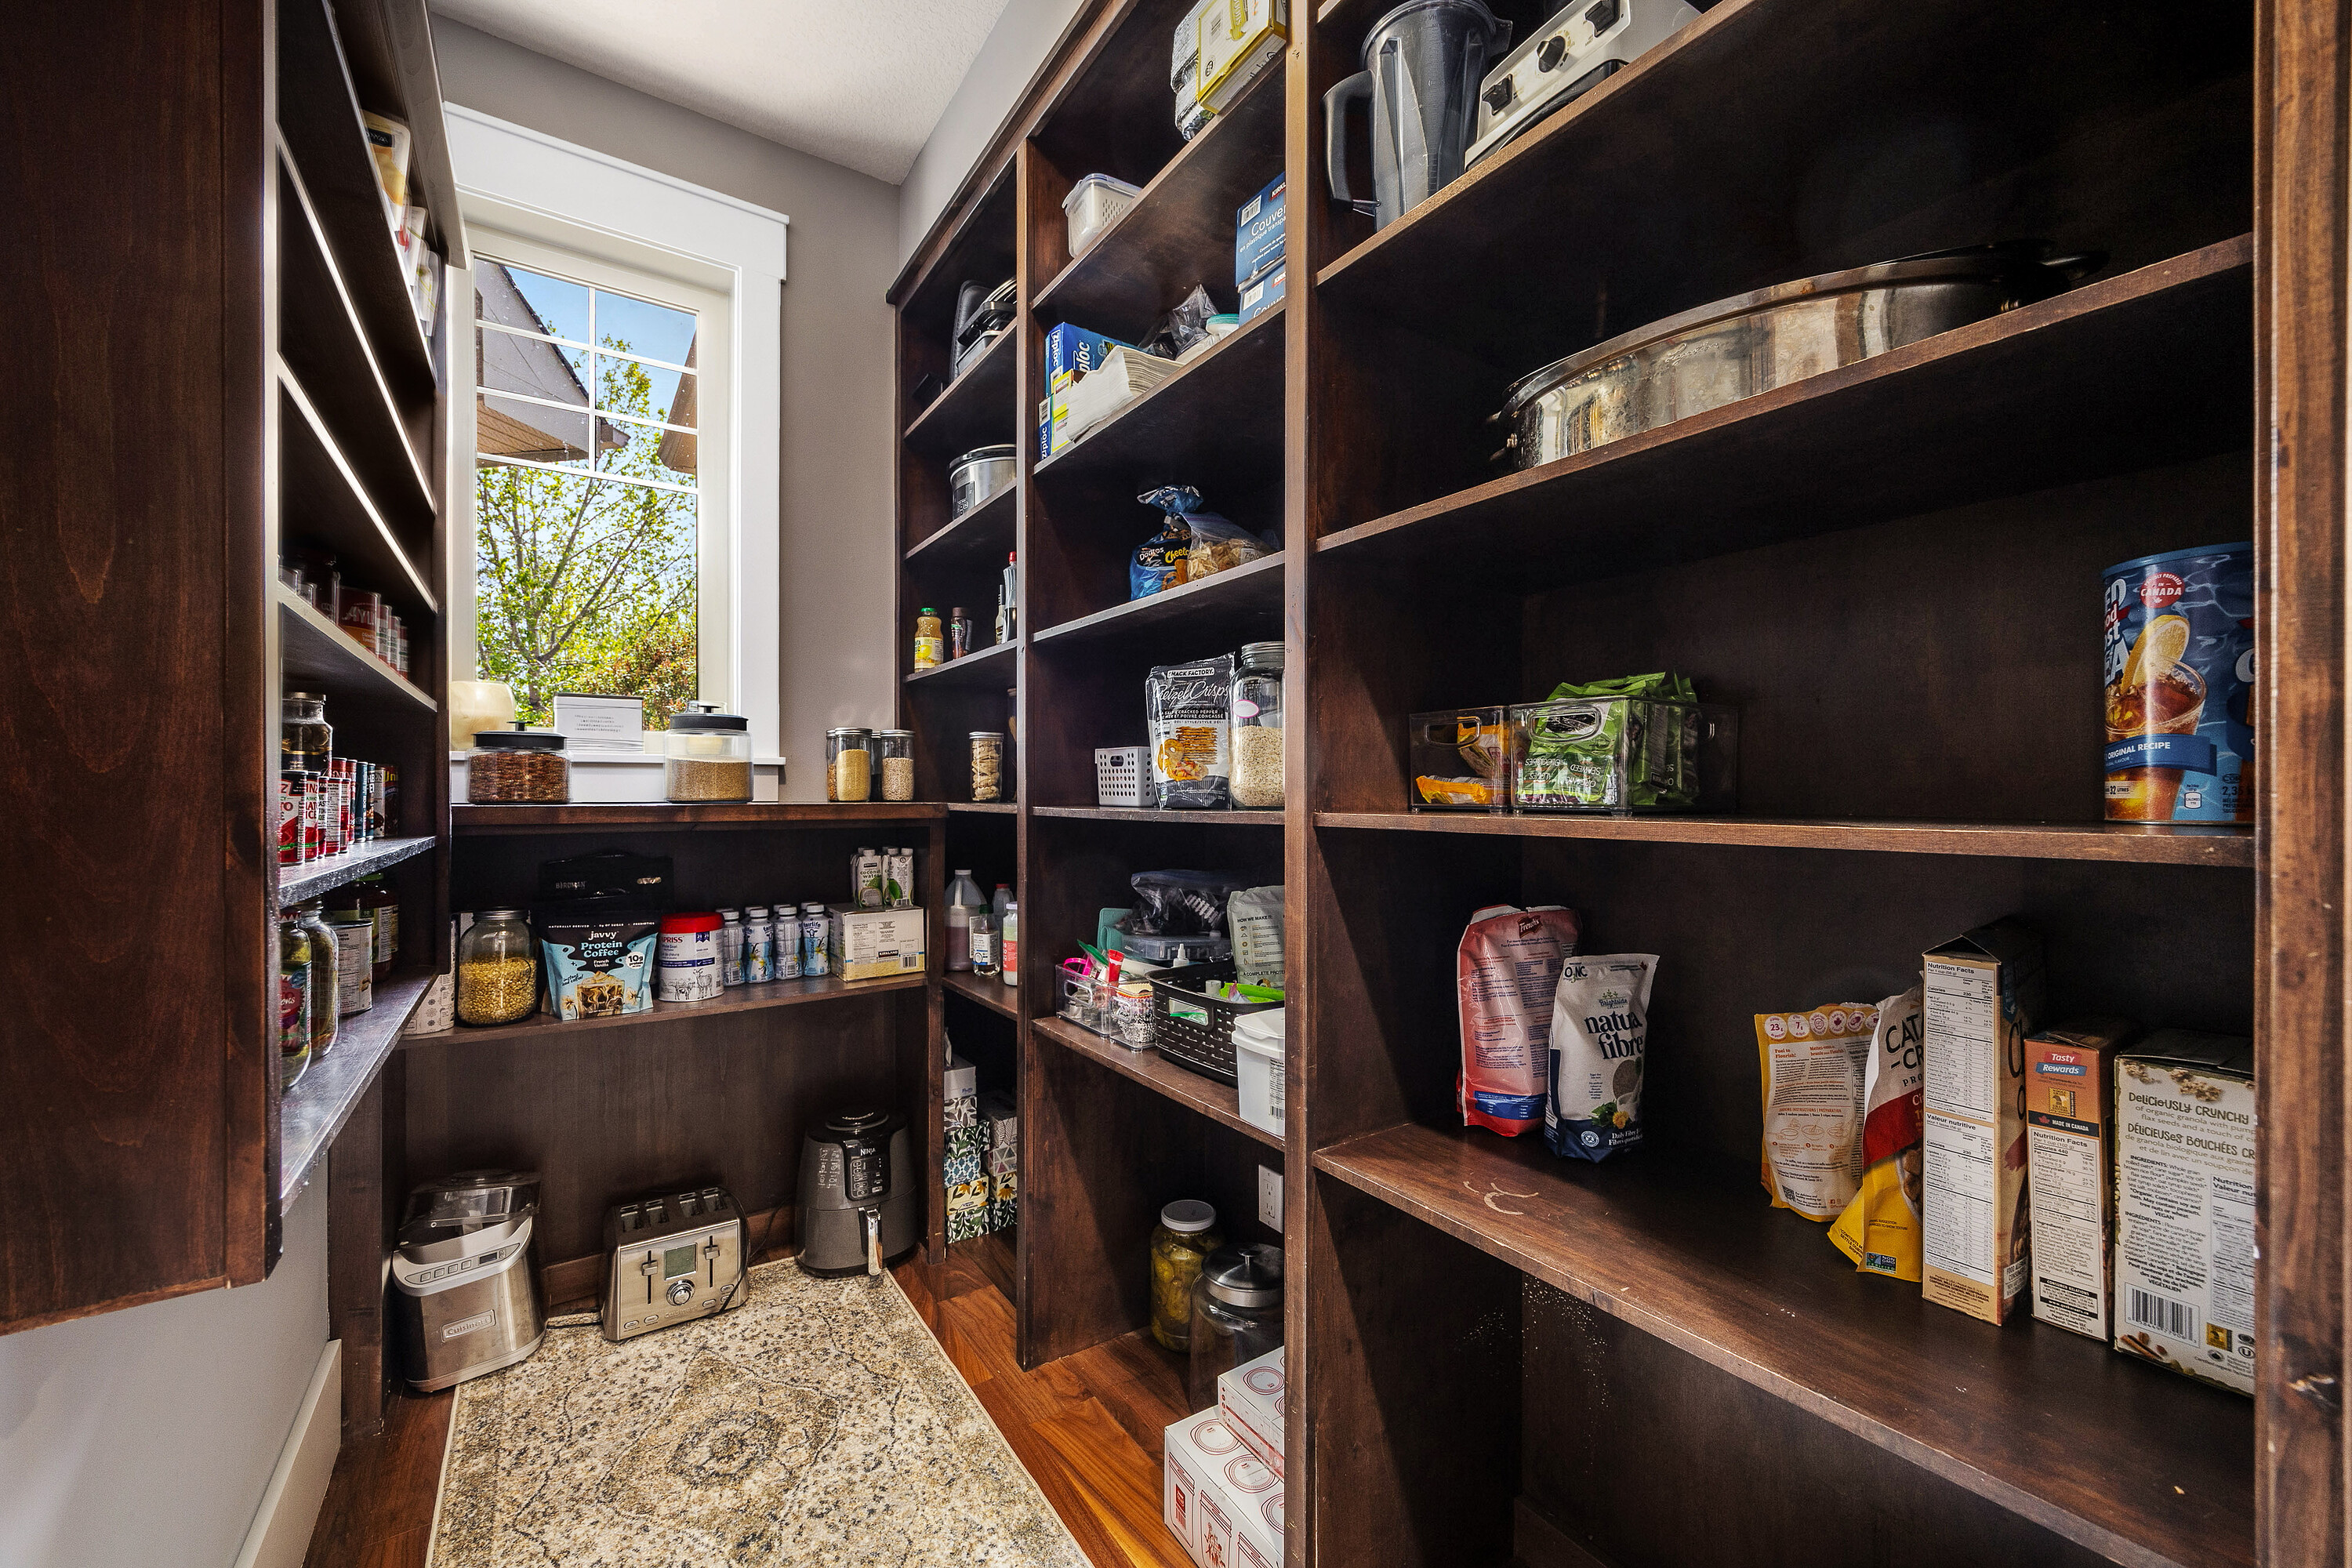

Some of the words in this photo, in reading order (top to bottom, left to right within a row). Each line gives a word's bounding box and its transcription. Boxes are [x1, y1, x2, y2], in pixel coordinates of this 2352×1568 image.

[1246, 229, 1268, 249] plastique
[1052, 329, 1061, 367] Ziploc
[1078, 341, 1091, 372] ploc
[1139, 547, 1164, 561] Doritos
[2162, 573, 2183, 586] PREPARED
[2140, 587, 2182, 597] CANADA
[1190, 681, 1229, 707] Crisps
[2107, 746, 2136, 760] ORIGINAL
[2137, 742, 2171, 751] RECIPE
[1570, 764, 1601, 775] SEAWEED
[2110, 785, 2117, 794] 32
[1519, 917, 1540, 933] French's
[588, 931, 617, 941] javvy
[581, 941, 623, 950] Protein
[583, 949, 619, 958] Coffee
[1584, 1011, 1642, 1033] natua
[1598, 1032, 1643, 1060] fibre
[2052, 1054, 2075, 1063] Tasty
[2042, 1064, 2079, 1074] Rewards
[1926, 1113, 1947, 1123] Valeur
[1948, 1119, 1976, 1130] nutritive
[2145, 1108, 2175, 1120] organic
[2176, 1113, 2208, 1125] granola
[2071, 1123, 2089, 1131] CANADA
[2141, 1113, 2156, 1122] flax
[2157, 1118, 2180, 1127] seeds
[2206, 1127, 2232, 1138] touch
[2034, 1131, 2065, 1142] Nutrition
[2067, 1138, 2088, 1148] Facts
[2034, 1143, 2057, 1152] Calories
[2136, 1136, 2165, 1148] granola
[2165, 1142, 2209, 1157] biologique
[2034, 1163, 2065, 1173] Carbohydrate
[2130, 1155, 2169, 1168] INGREDIENTS:
[2172, 1153, 2190, 1162] avec
[2204, 1160, 2241, 1173] soupçon
[2034, 1180, 2061, 1190] Cholesterol
[2165, 1177, 2189, 1185] pumpkin
[2212, 1176, 2253, 1190] Nutrition
[2212, 1182, 2240, 1194] Valeur
[2154, 1194, 2179, 1204] Contains
[2154, 1211, 2175, 1220] VEGAN
[1867, 1261, 1895, 1271] VERIFIED
[2148, 1278, 2182, 1293] VÉGÉTALIEN
